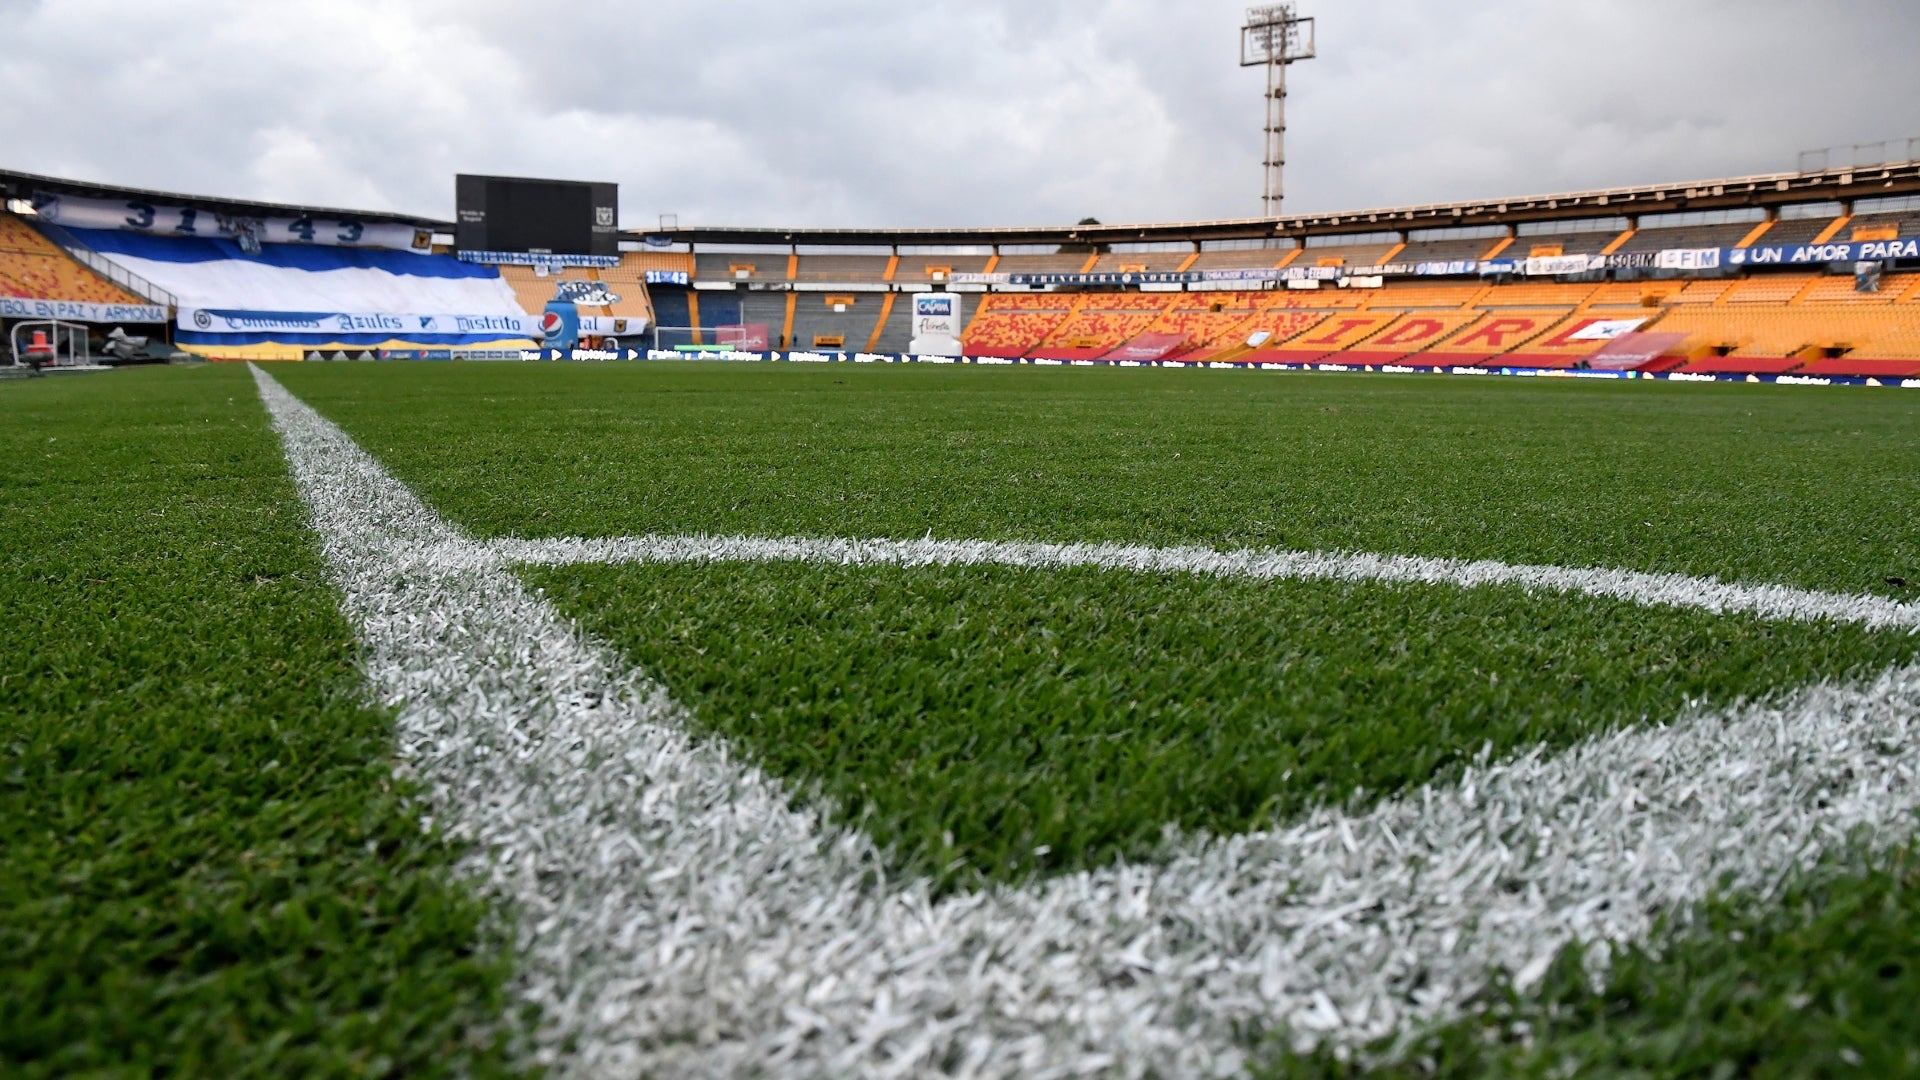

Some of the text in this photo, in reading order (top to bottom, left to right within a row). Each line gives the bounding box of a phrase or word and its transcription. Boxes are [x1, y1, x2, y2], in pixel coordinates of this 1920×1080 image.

[1751, 240, 1919, 262] UN AMOR PARA
[35, 302, 55, 316] EN
[58, 303, 86, 318] PAZ
[89, 305, 99, 322] Y
[337, 313, 403, 331] Azules
[455, 315, 520, 332] Distrito
